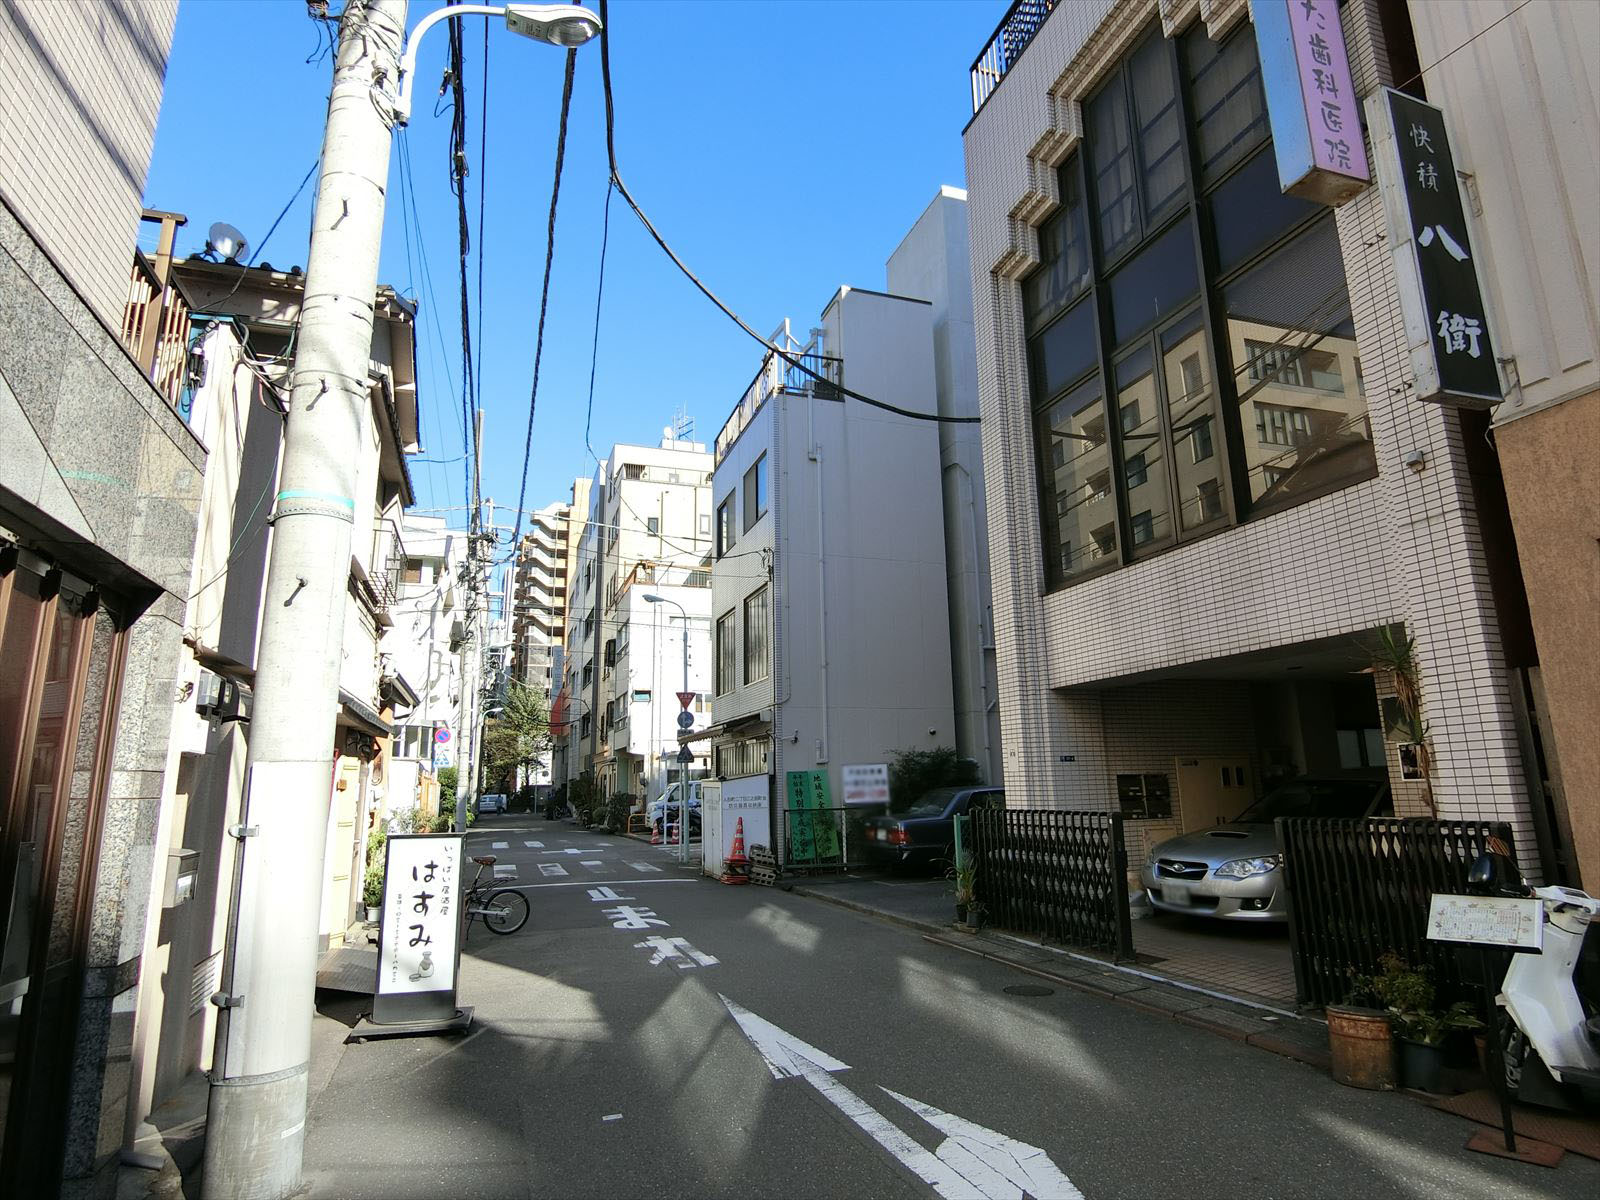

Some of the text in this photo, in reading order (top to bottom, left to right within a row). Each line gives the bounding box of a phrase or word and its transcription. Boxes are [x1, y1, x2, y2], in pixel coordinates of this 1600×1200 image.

[408, 860, 439, 948] はすみ
[587, 886, 721, 969] 止まれ
